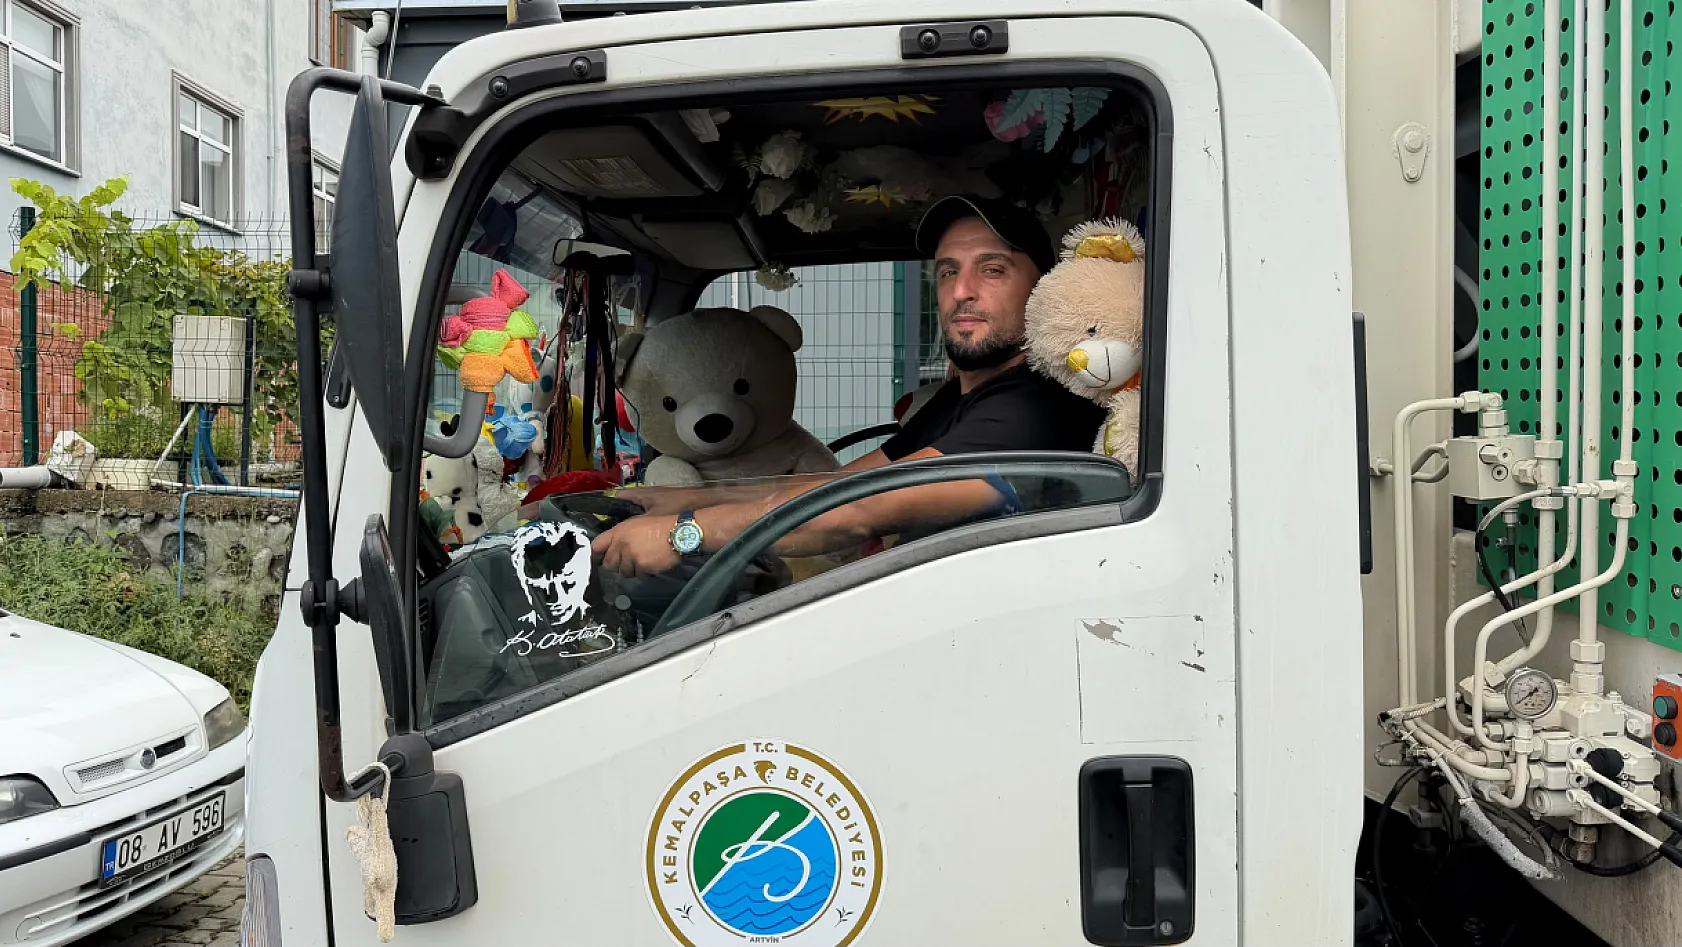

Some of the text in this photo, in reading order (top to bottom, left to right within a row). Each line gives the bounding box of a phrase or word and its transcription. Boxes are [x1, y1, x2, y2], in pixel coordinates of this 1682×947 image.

[753, 742, 778, 752] T.C.
[118, 835, 143, 868] 08
[158, 817, 182, 852] AV
[192, 801, 219, 836] 596
[662, 765, 748, 884] KEMALPAŞA
[105, 861, 115, 872] TR
